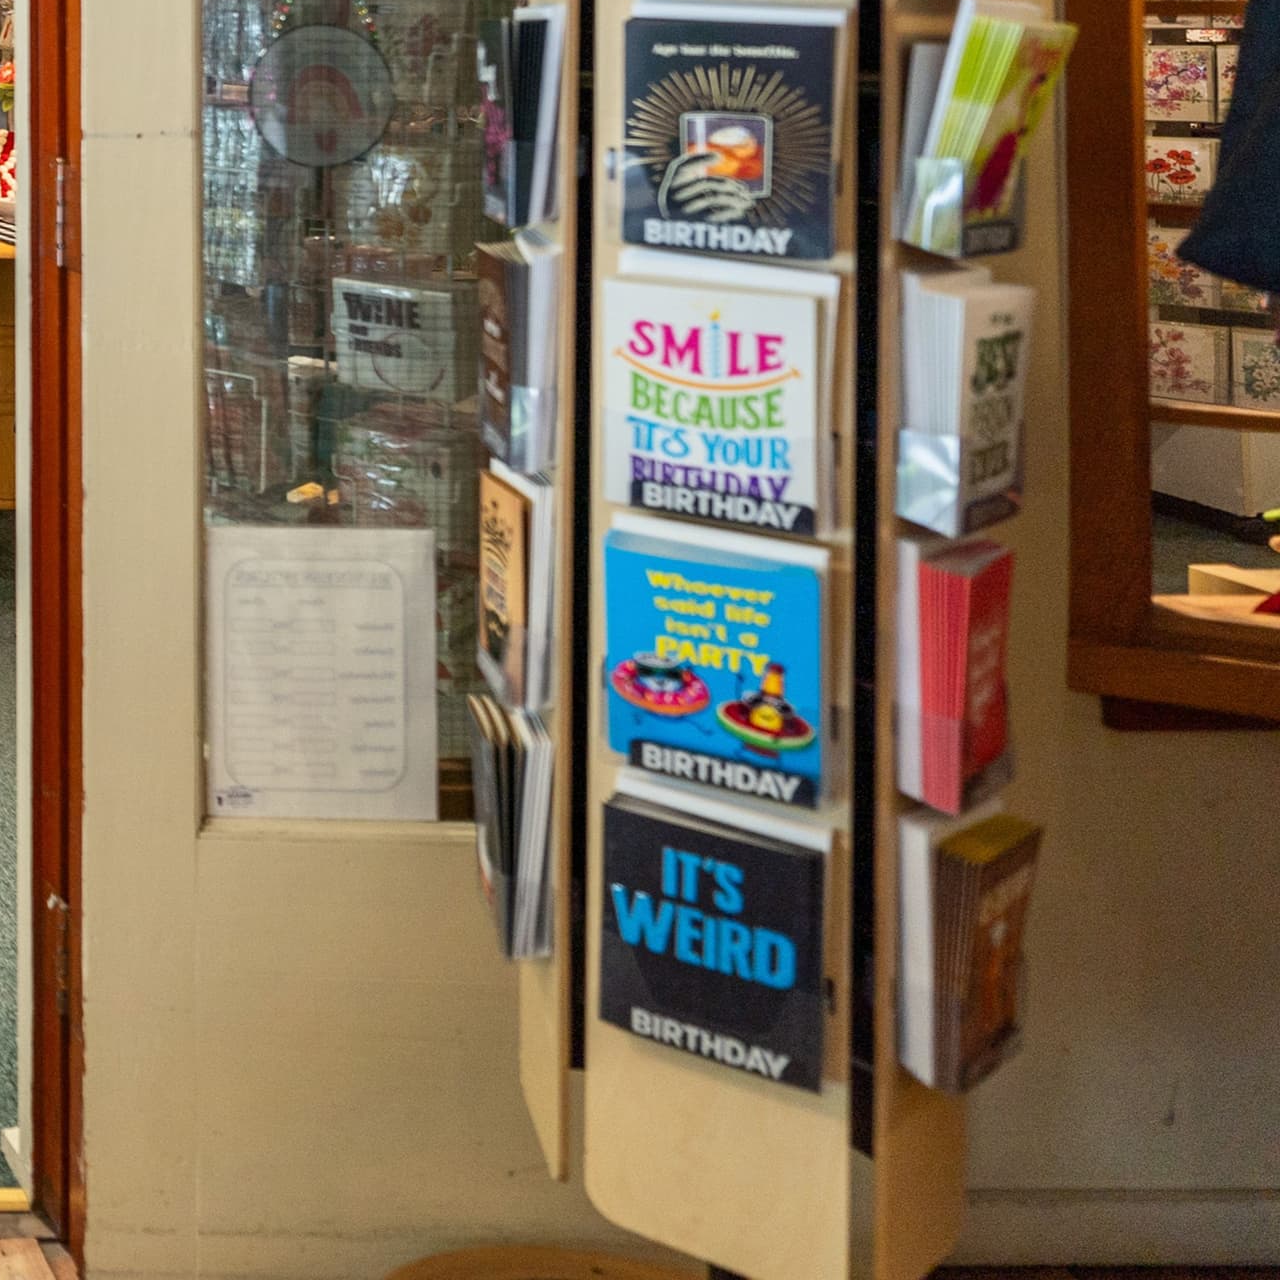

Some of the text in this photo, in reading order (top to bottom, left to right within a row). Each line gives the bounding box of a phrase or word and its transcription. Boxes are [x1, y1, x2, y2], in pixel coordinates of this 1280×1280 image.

[644, 219, 794, 255] BIRTHDAY
[627, 319, 784, 376] SMILE
[629, 370, 785, 430] BECAUSE
[701, 432, 793, 471] YOUR
[642, 482, 802, 531] BIRTHDAY
[646, 568, 775, 606] Whoever
[653, 594, 770, 627] said life
[654, 635, 771, 678] PARTY
[665, 616, 759, 648] isn't a
[640, 742, 802, 803] BIRTHDAY
[660, 846, 744, 916] IT'S
[611, 883, 797, 991] WEIRD
[630, 1006, 790, 1081] BIRTHDAY
